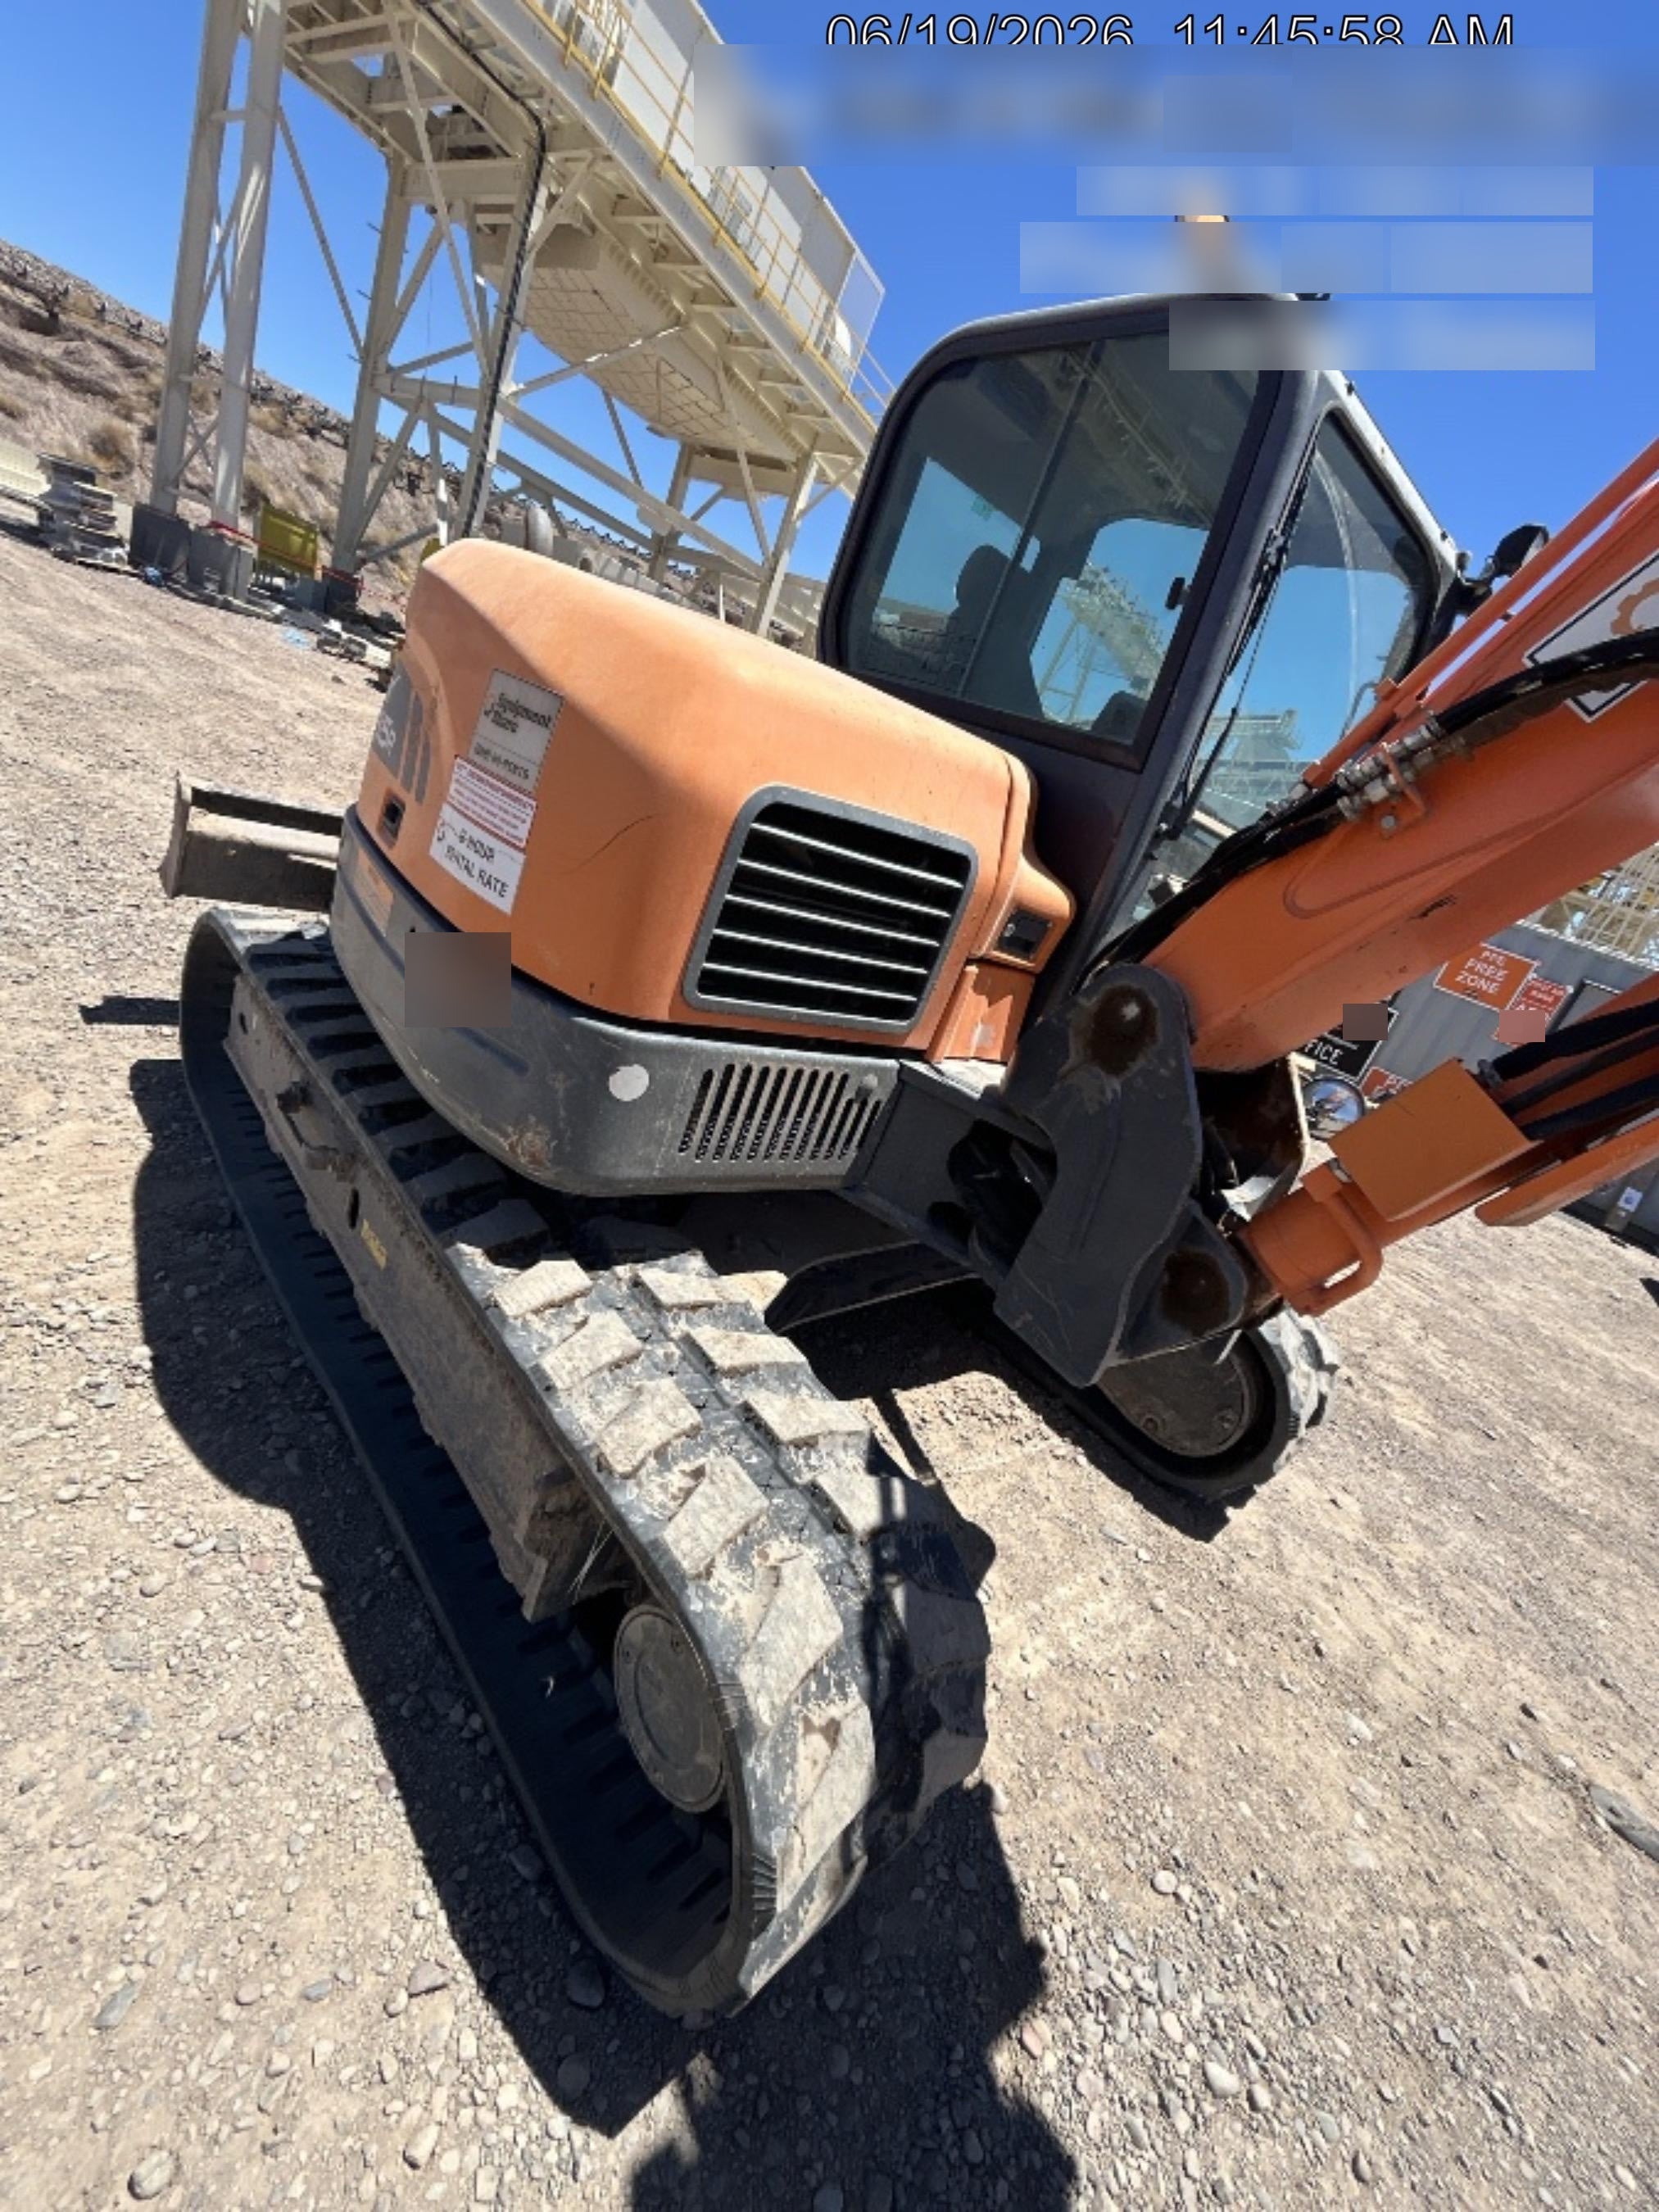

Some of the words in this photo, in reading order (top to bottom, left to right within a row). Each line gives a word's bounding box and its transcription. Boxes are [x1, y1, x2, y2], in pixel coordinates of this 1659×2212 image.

[477, 868, 509, 899] RATE
[1454, 970, 1502, 995] ZONE
[1464, 958, 1509, 982] FREE
